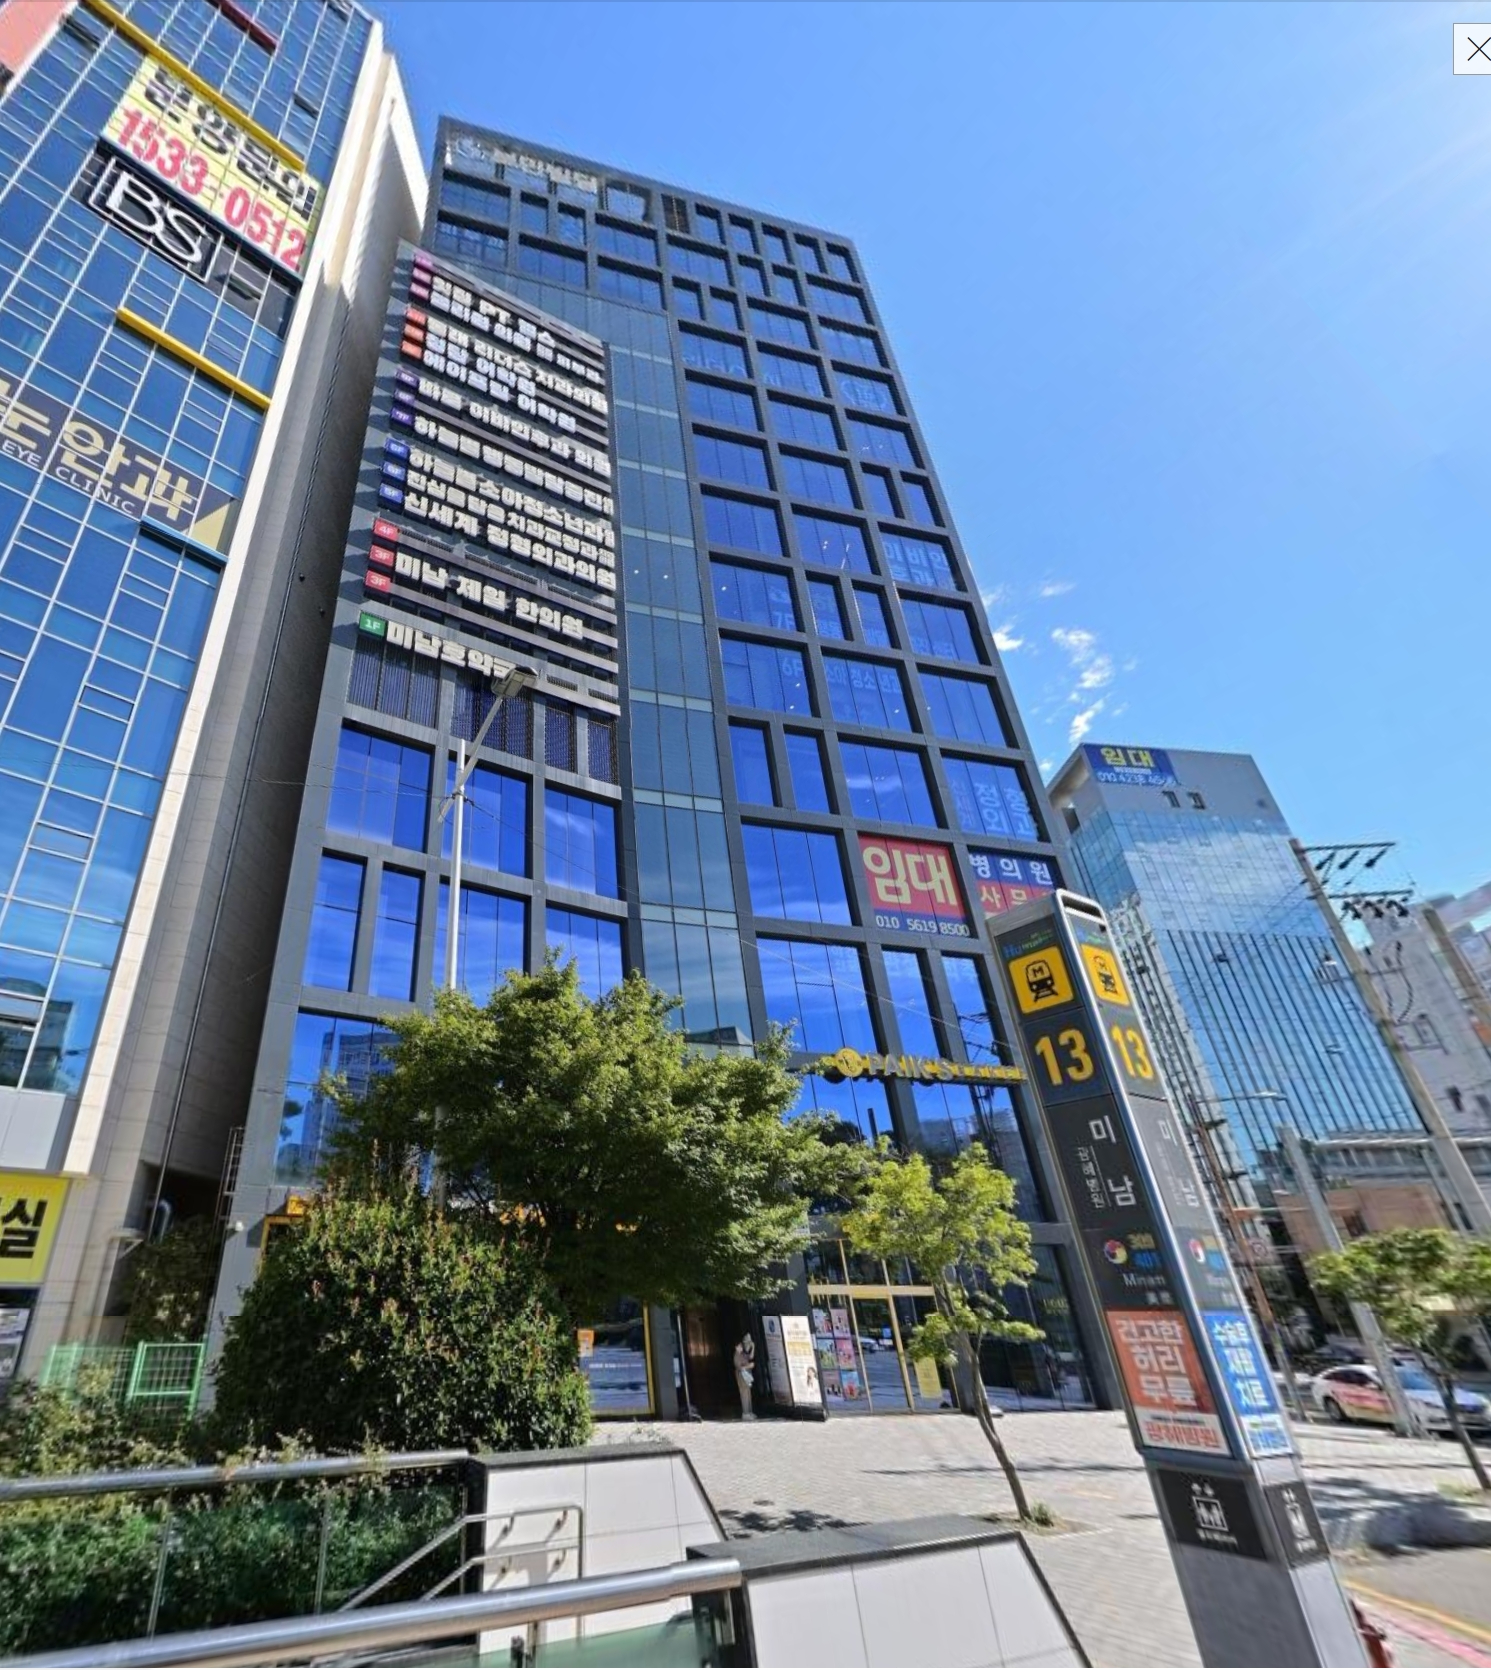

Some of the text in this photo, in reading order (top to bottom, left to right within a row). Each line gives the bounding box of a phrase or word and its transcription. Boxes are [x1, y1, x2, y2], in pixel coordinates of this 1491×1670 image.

[2, 439, 136, 514] EYE CLINIC
[404, 493, 480, 537] 신세계
[396, 552, 448, 589] 미남
[456, 575, 506, 612] 제일
[516, 597, 583, 640] 한의원
[1101, 747, 1155, 767] 임대
[863, 846, 958, 906] 임대
[876, 914, 970, 937] 010 5619 8500
[1035, 1028, 1094, 1085] 13
[1111, 1025, 1153, 1080] 13
[1089, 1115, 1136, 1206] 미남
